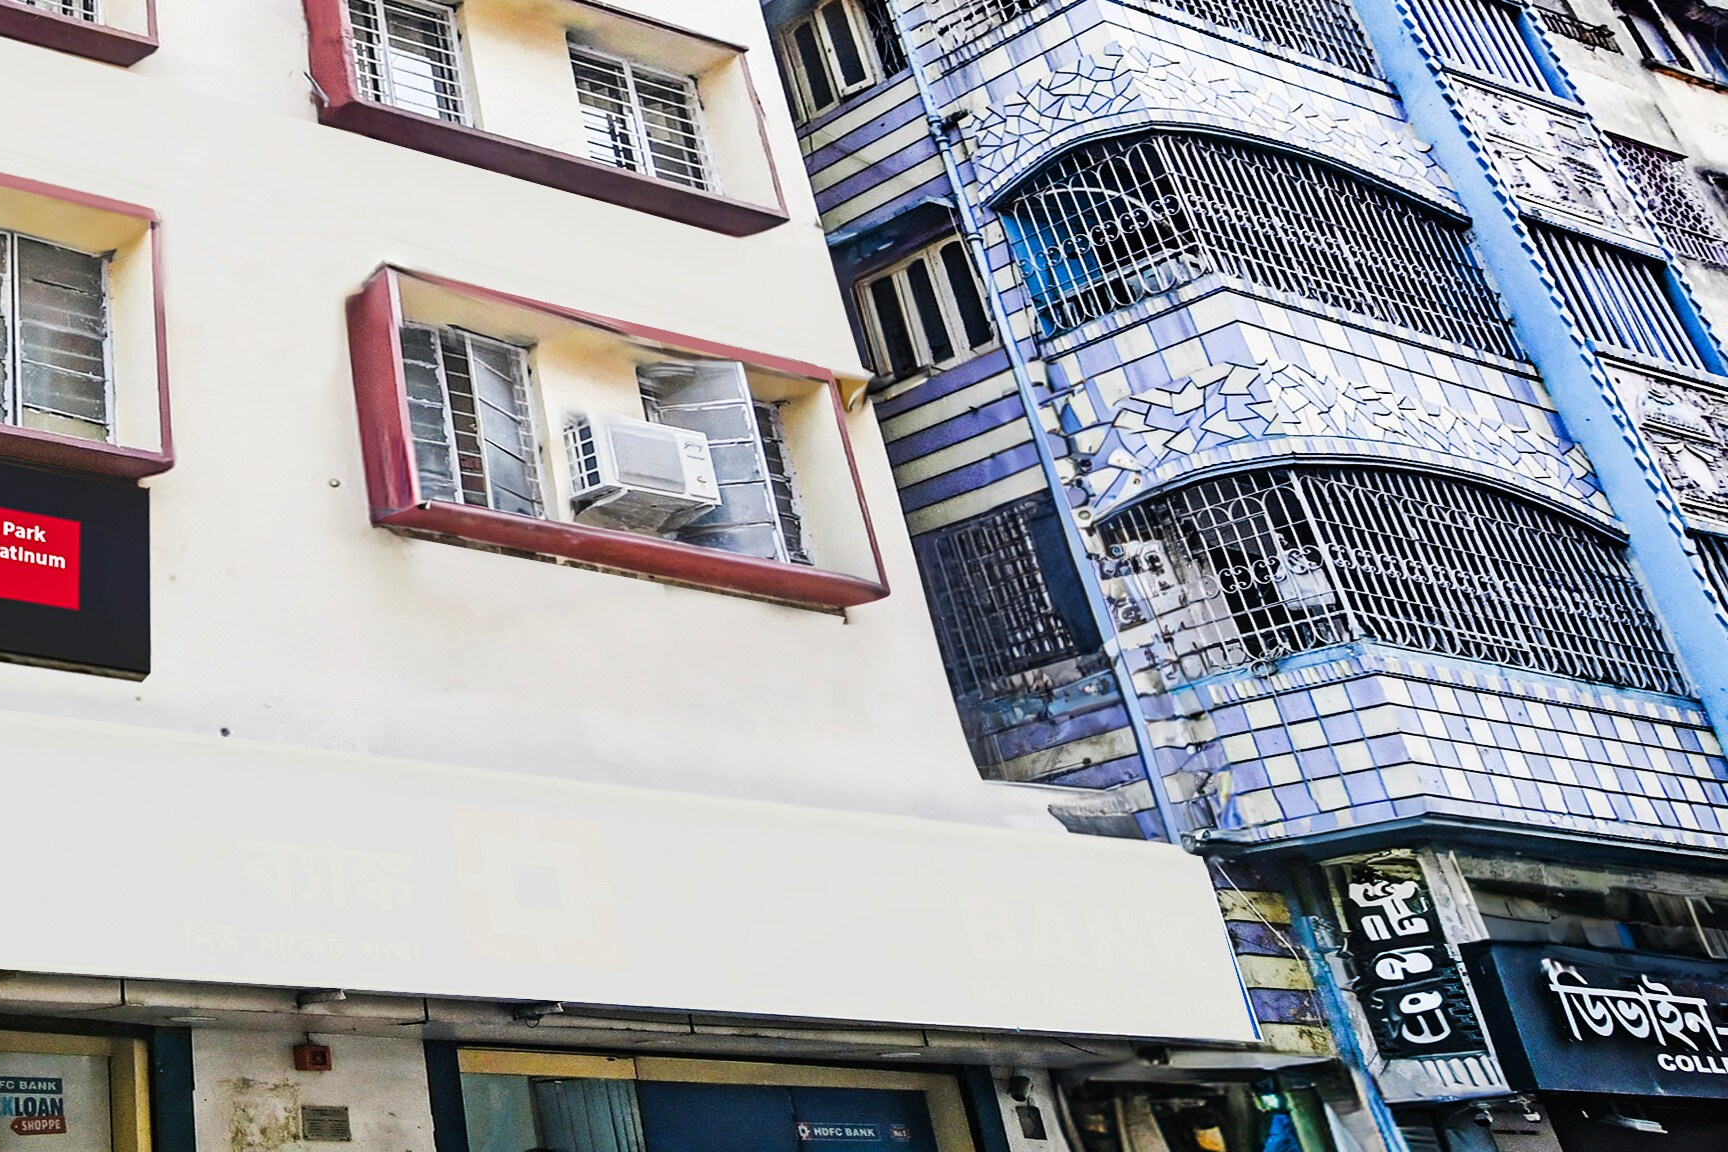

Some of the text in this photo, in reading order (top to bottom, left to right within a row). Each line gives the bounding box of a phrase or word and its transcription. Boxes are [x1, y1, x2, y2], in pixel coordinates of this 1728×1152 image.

[3, 521, 47, 543] Park
[19, 1081, 57, 1090] BANK
[21, 1119, 61, 1132] SHOPPE
[813, 1127, 876, 1137] HDFC BANK
